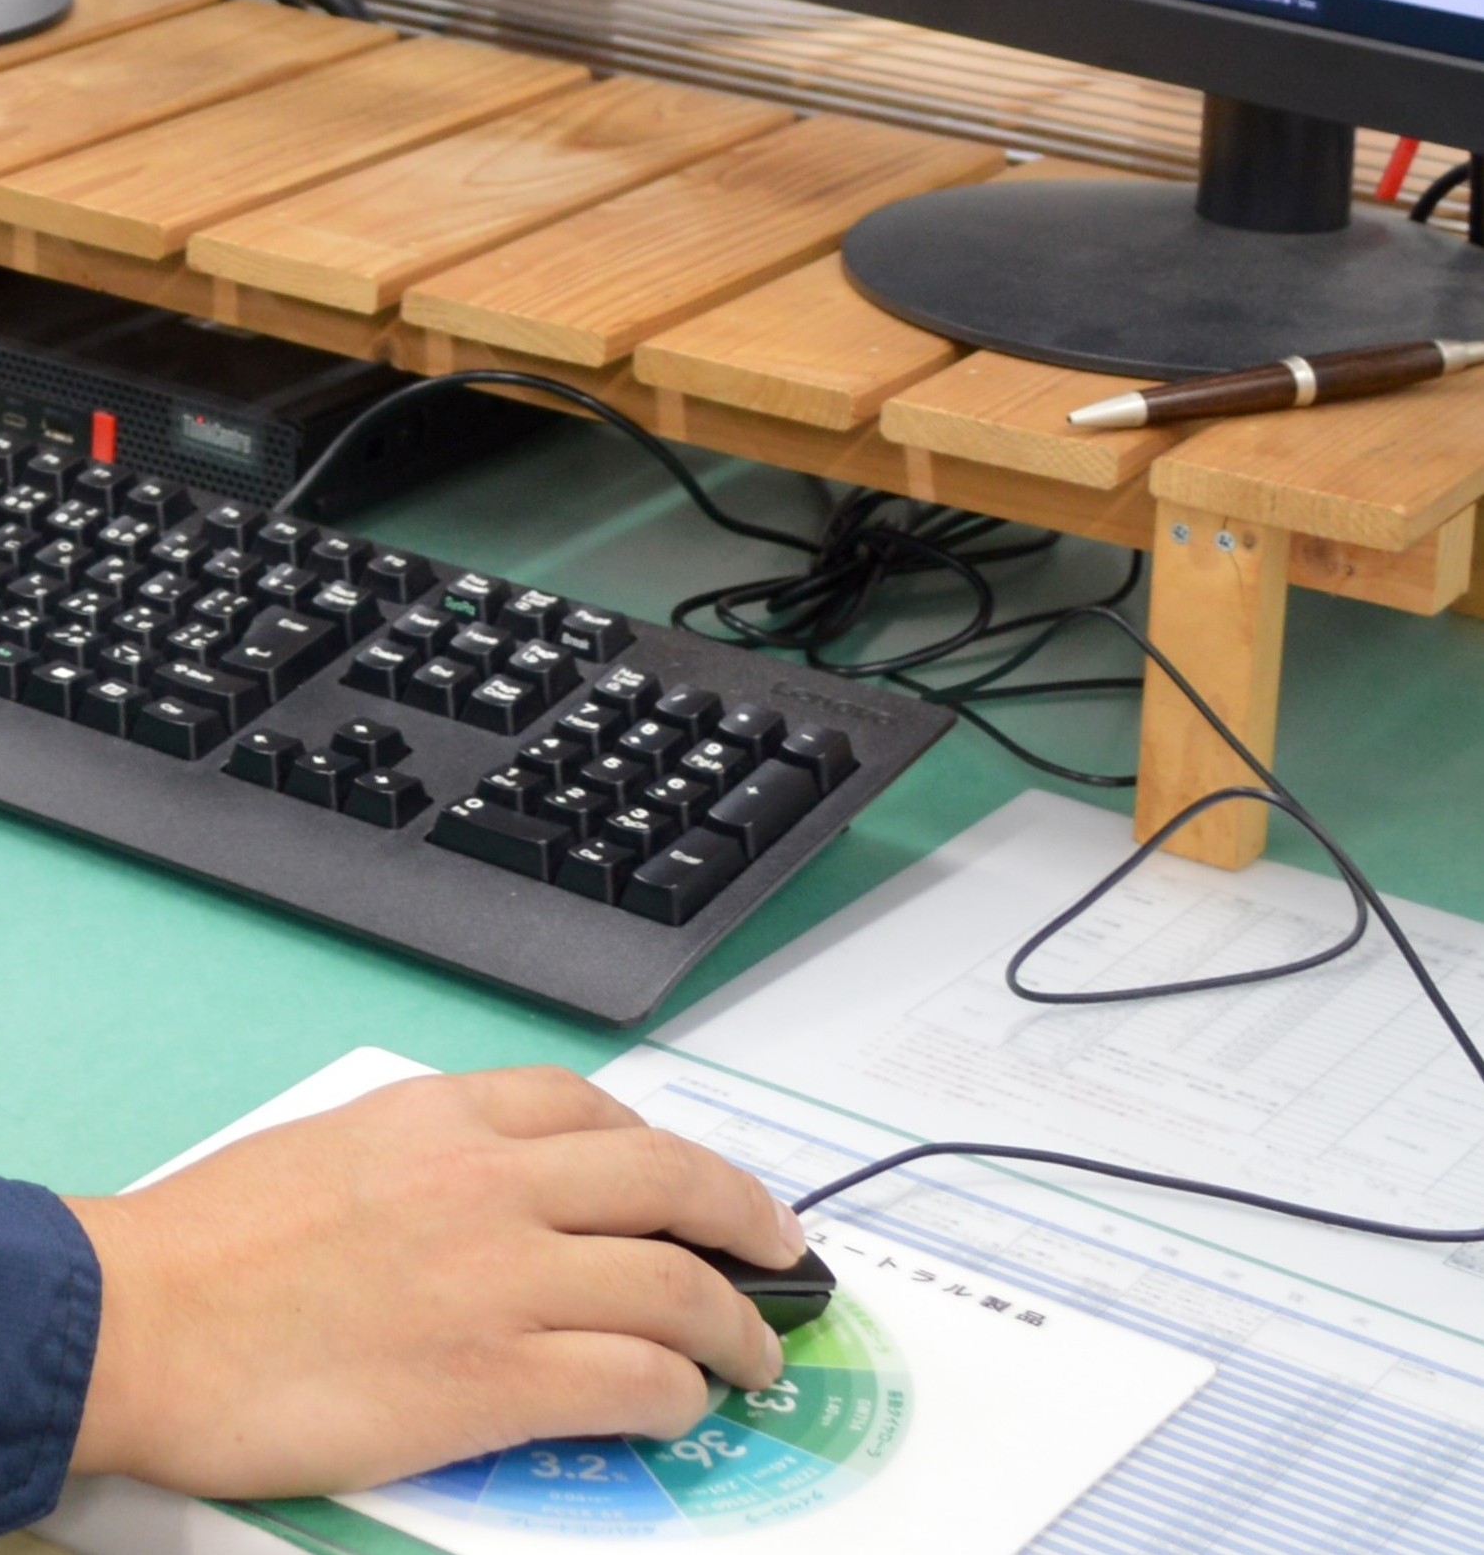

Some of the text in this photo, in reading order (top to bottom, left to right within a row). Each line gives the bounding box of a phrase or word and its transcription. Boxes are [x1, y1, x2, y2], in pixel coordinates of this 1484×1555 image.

[579, 702, 599, 714] 7
[564, 714, 600, 730] Home
[640, 722, 659, 736] 8
[542, 738, 560, 748] 4
[703, 742, 723, 756] 9
[602, 757, 622, 769] 5
[667, 777, 687, 790] 6
[565, 787, 586, 799] 2
[464, 797, 484, 809] 0
[629, 808, 650, 820] 3
[669, 849, 703, 865] Enter
